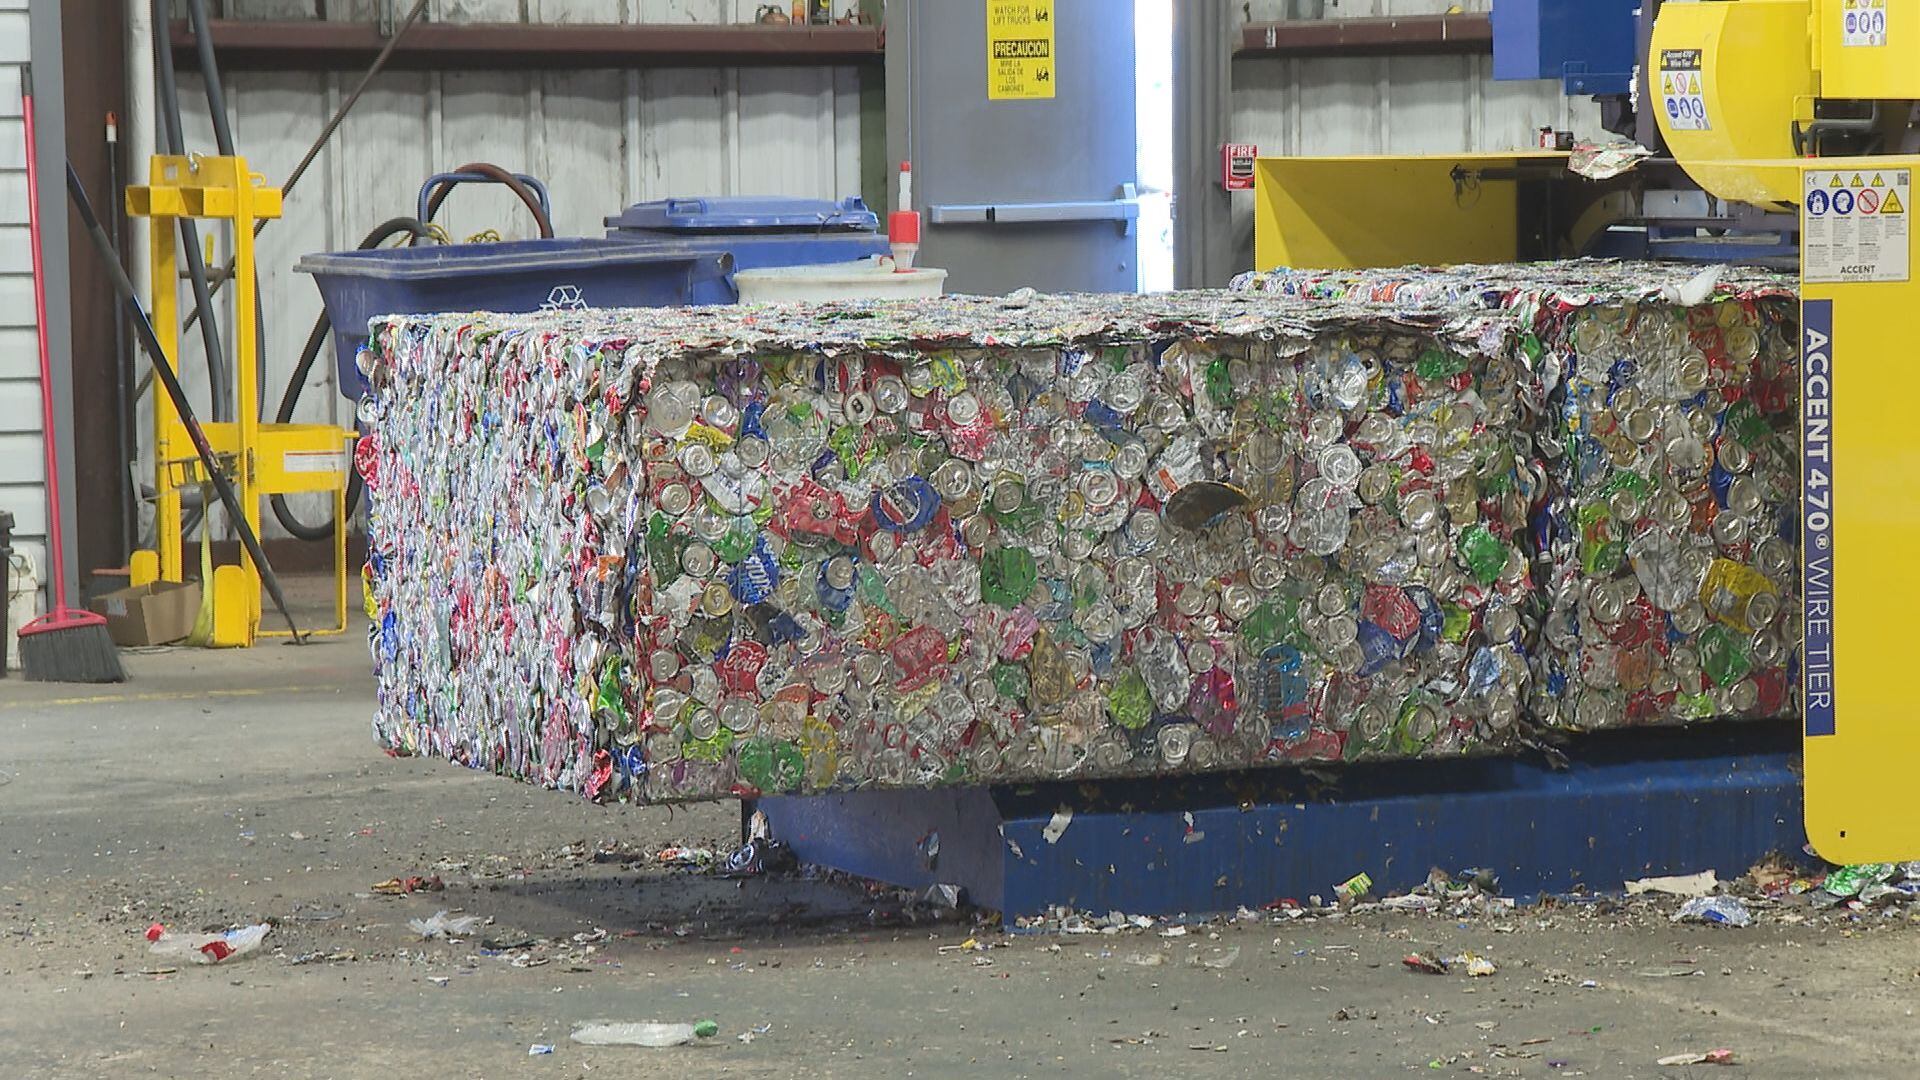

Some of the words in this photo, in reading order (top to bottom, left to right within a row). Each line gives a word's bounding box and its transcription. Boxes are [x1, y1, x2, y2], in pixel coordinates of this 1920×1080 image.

[1230, 146, 1255, 157] FIRE
[1840, 265, 1876, 275] ACCENT
[1806, 327, 1829, 463] ACCENT
[1808, 556, 1830, 637] WIRE
[1808, 643, 1831, 710] TIER
